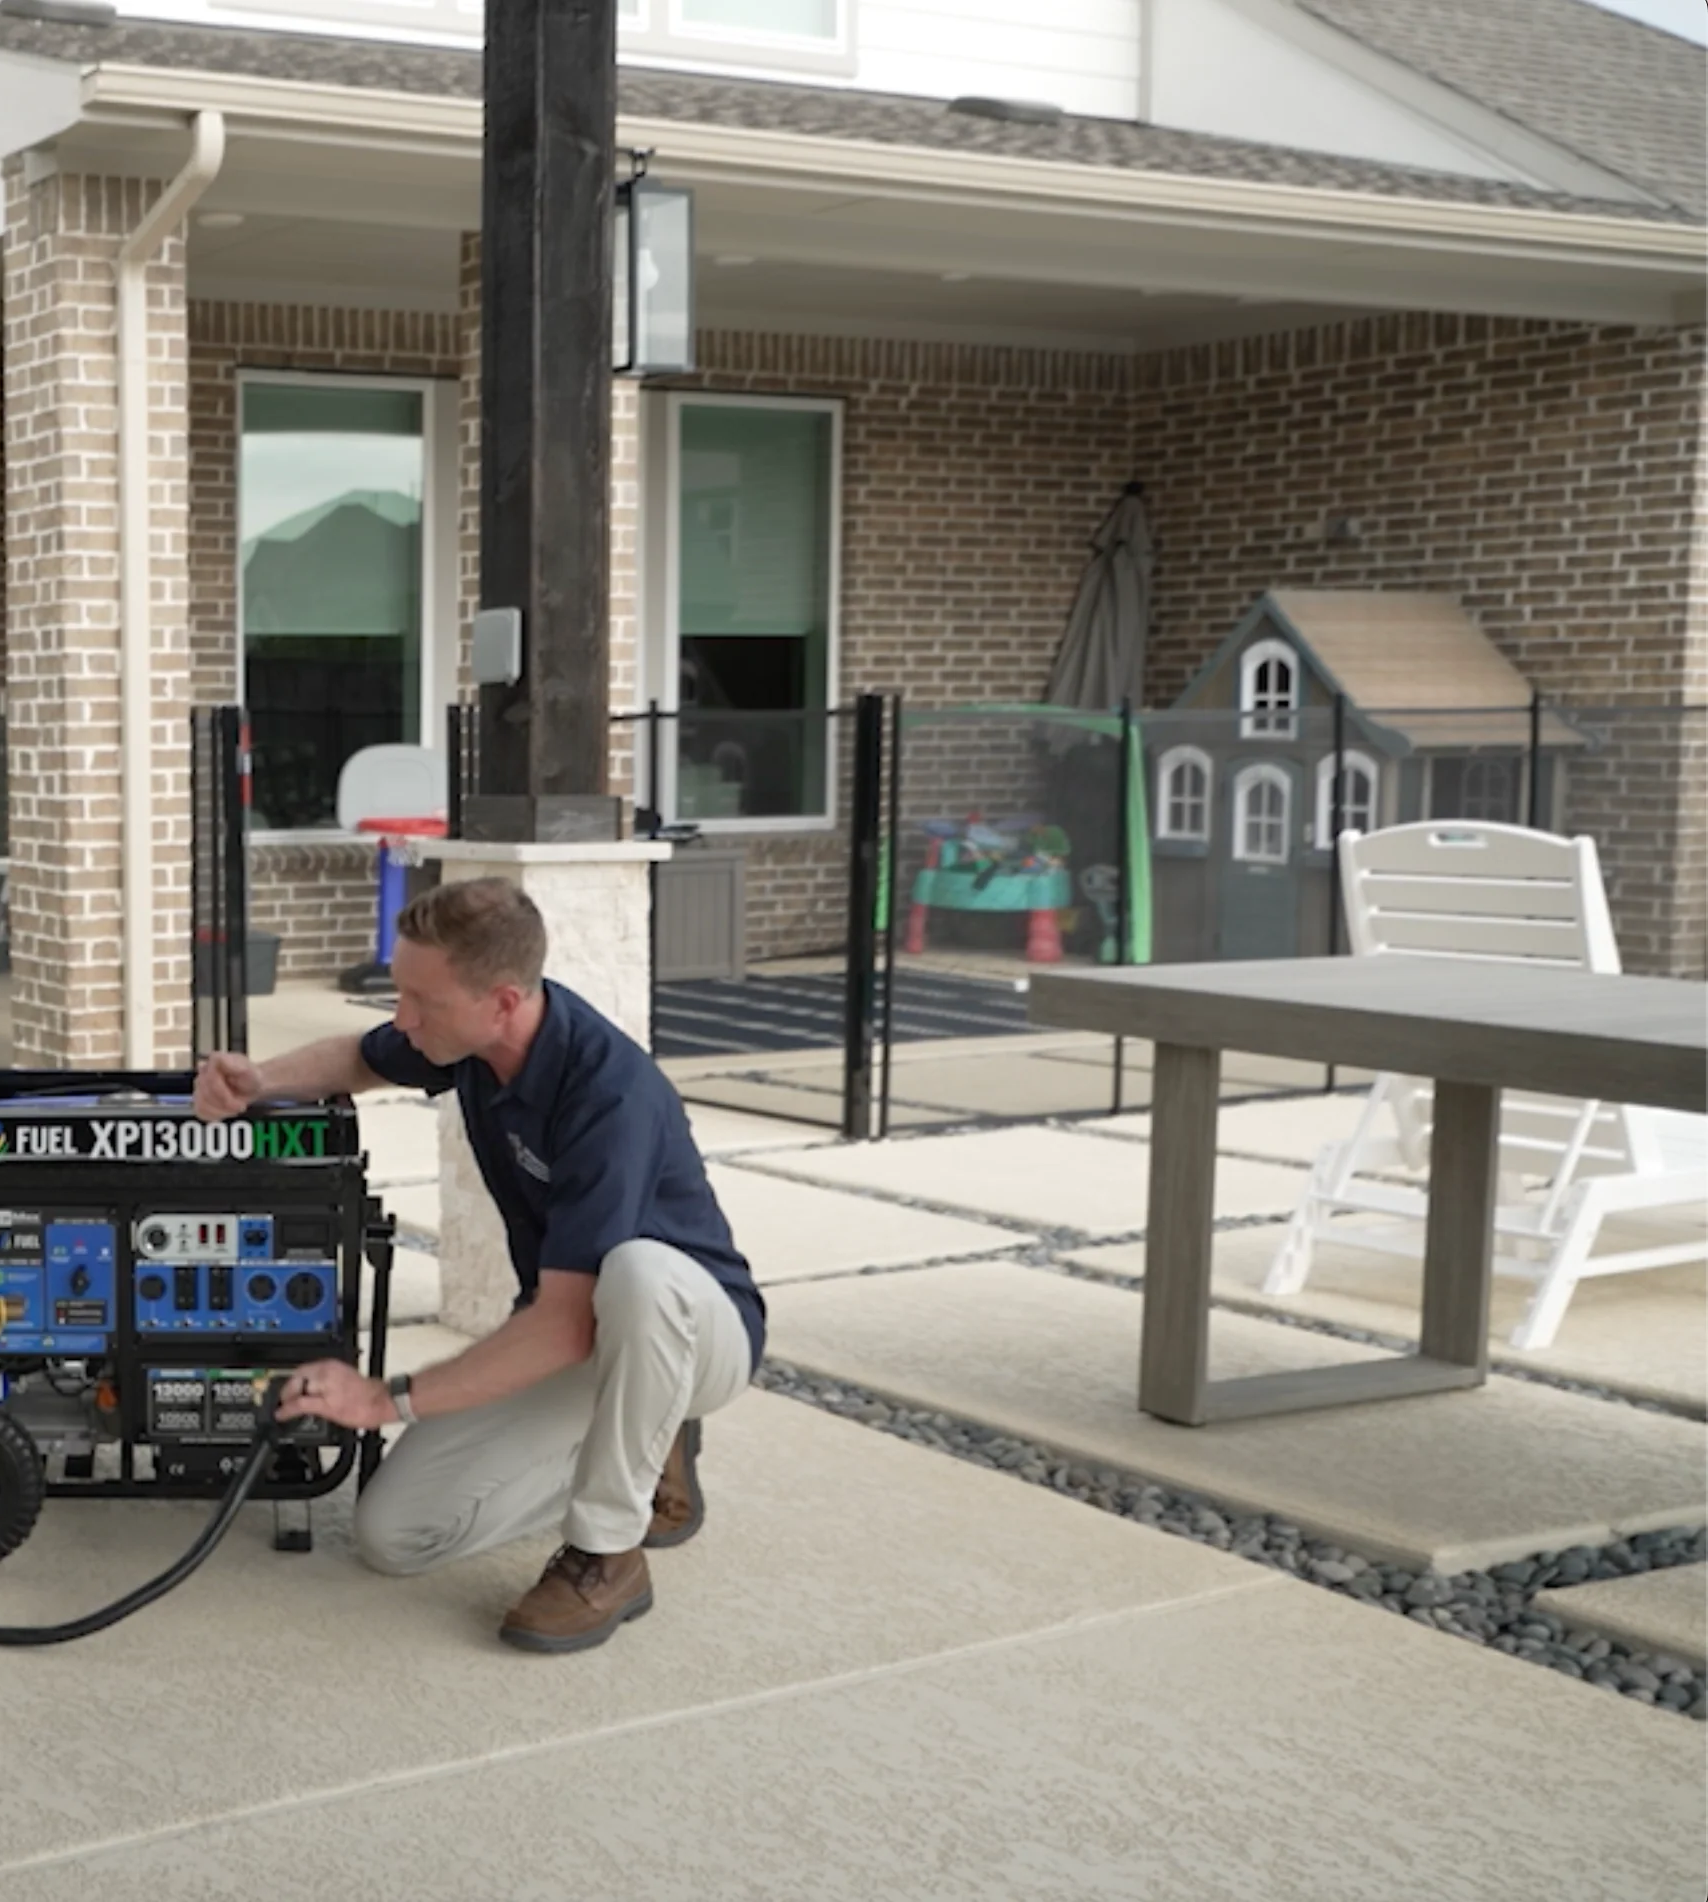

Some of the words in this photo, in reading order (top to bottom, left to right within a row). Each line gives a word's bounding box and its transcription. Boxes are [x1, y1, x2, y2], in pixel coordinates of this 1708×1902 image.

[15, 1127, 77, 1155] FUEL
[89, 1120, 330, 1159] XP13000HXT
[13, 1234, 41, 1249] FUEL
[153, 1383, 204, 1396] 13000
